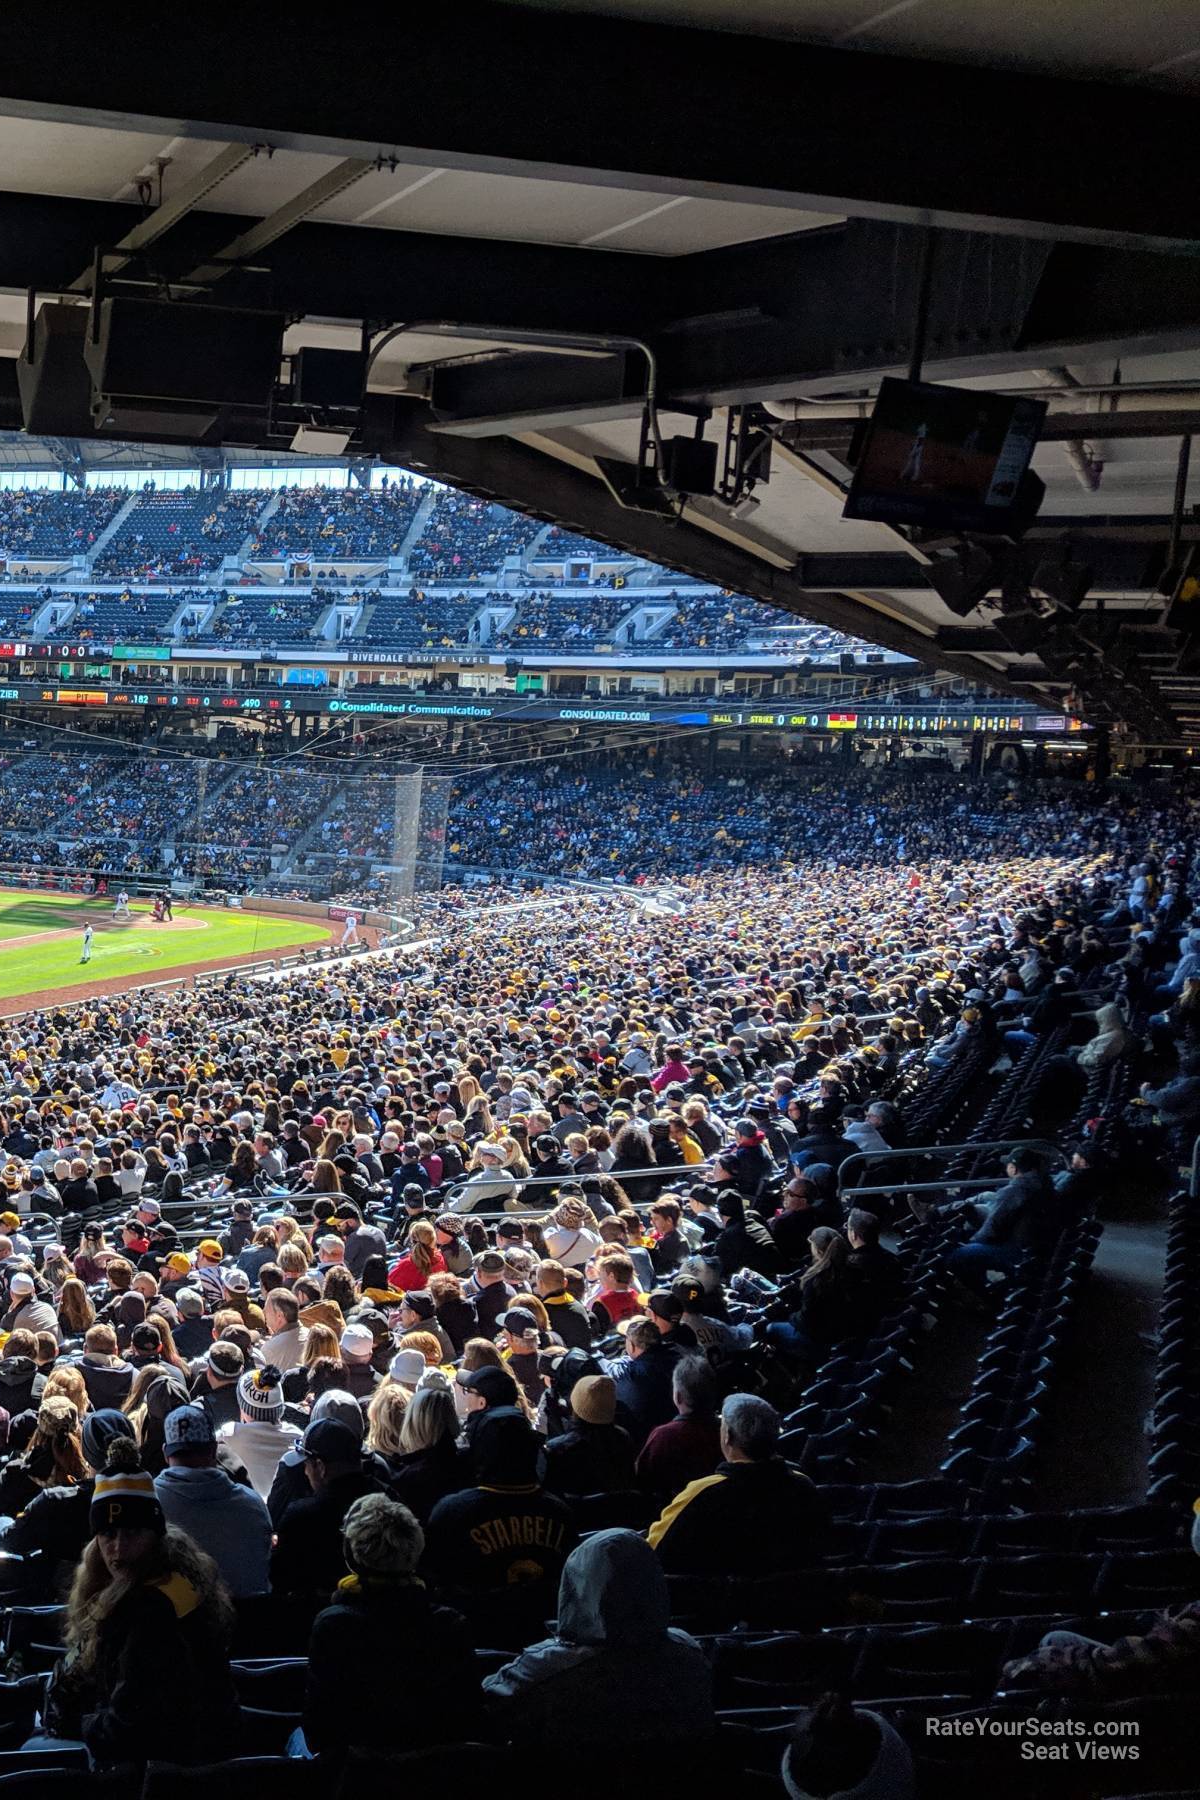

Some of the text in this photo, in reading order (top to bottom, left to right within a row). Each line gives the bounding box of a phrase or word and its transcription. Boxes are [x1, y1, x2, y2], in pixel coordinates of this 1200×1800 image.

[46, 645, 52, 656] 1
[61, 645, 69, 656] 0
[77, 646, 85, 657] 0
[452, 656, 485, 664] LEVEL
[76, 693, 89, 702] PIT
[131, 695, 149, 704] .182
[171, 696, 178, 705] 0
[203, 697, 210, 706] 0
[222, 698, 238, 706] OPS
[241, 698, 261, 708] .490
[284, 699, 291, 709] 2
[340, 702, 492, 716] Consolidated Communications
[559, 709, 650, 721] CONSOLIDATED.COM
[713, 713, 819, 726] BALL 1 STRIKE 0 OUT 0
[689, 1290, 698, 1300] P
[108, 1503, 122, 1524] P
